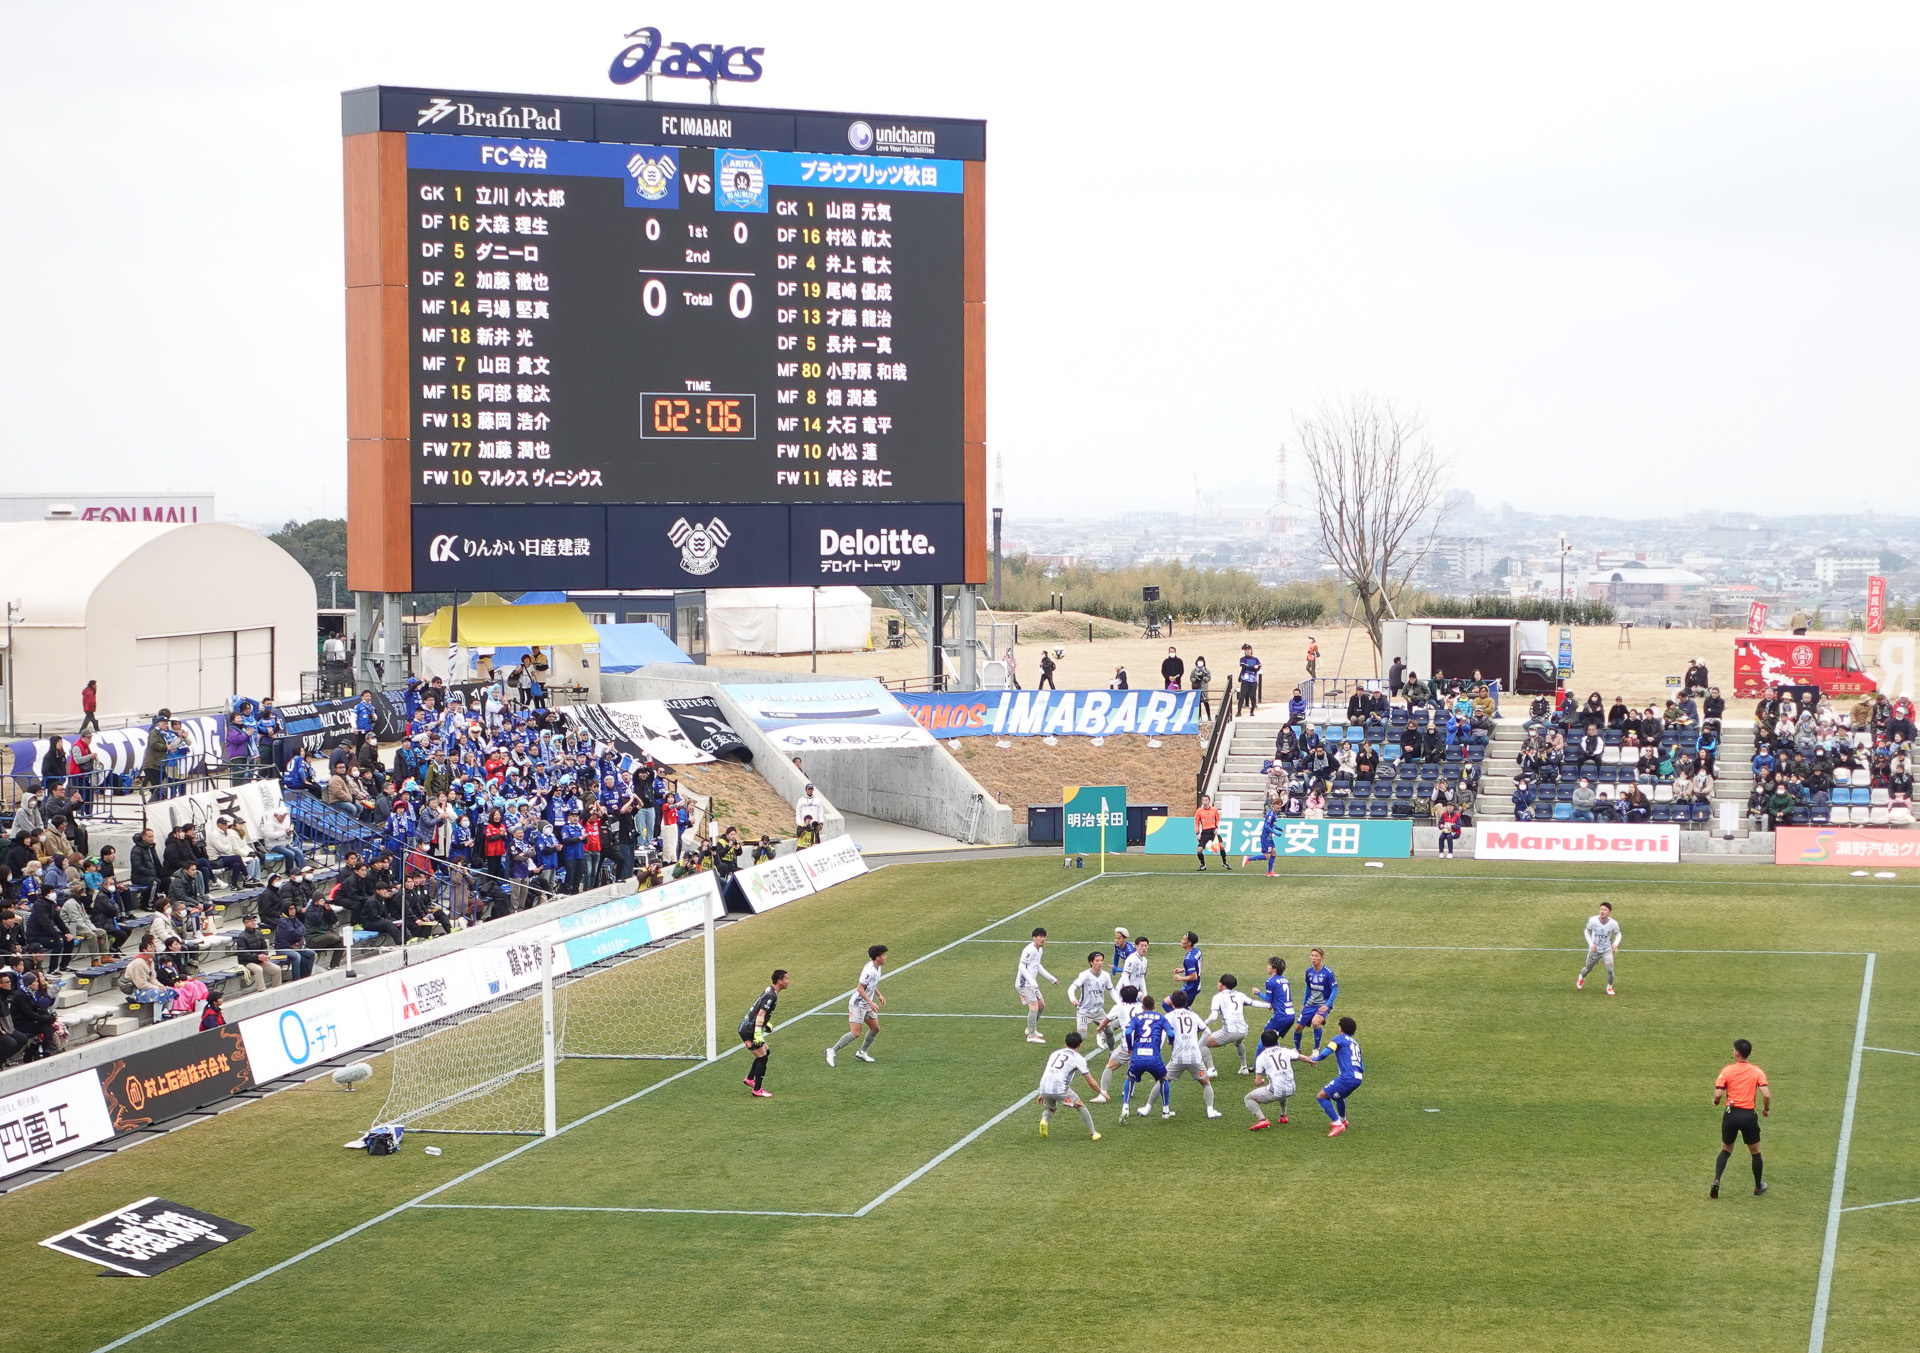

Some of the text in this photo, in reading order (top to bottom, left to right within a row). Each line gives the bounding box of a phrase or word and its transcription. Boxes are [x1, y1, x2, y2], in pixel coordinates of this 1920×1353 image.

[661, 41, 765, 84] asics
[457, 102, 562, 131] BrainPad
[662, 116, 732, 138] FC IMABARI
[876, 126, 935, 145] unicharm
[482, 146, 548, 170] FC今治
[890, 145, 902, 153] Your
[902, 146, 935, 154] Possibilities
[729, 159, 755, 168] AKITA
[801, 161, 937, 187] ブラウブリッツ秋田
[683, 173, 712, 194] VS
[419, 184, 566, 209] GK 1 立川 小太郎
[775, 199, 893, 223] GK 1 山田 元気
[421, 213, 549, 236] DF 16 大森 理生
[646, 218, 748, 244] 0 1st 0
[777, 226, 893, 249] DF 16 村松 航太
[421, 241, 539, 262] DF 5 ダニーロ
[686, 249, 710, 263] 2nd
[777, 254, 892, 275] DF 4 井上 竜太
[422, 270, 550, 292] DF 2 加藤 徹也
[777, 280, 798, 297] DF
[802, 281, 821, 298] 19
[860, 281, 893, 302] 優成
[421, 299, 446, 315] MF
[450, 299, 471, 316] 14
[477, 298, 511, 319] 弓場
[643, 279, 753, 319] 0 Total 0
[777, 307, 893, 329] DF 13 才藤 龍治
[421, 326, 534, 347] MF 18 新井 光
[777, 334, 893, 355] DF 5 長井 一真
[422, 355, 551, 376] MF 7 山田 貴文
[777, 361, 908, 382] MF 80 小野原 和哉
[422, 384, 447, 400] MF
[451, 384, 472, 401] 15
[477, 382, 513, 403] 阿部
[685, 380, 712, 391] TIME
[777, 388, 799, 404] MF
[806, 388, 817, 405] 8
[825, 388, 843, 407] 畑
[422, 410, 551, 432] FW 13 藤岡 浩介
[654, 399, 742, 432] 02:06
[777, 415, 893, 435] MF 14 大石 竜平
[422, 440, 552, 460] FW 77 加藤 潤也
[776, 442, 879, 461] FW 10 小松 蓮
[422, 468, 604, 488] FW 10 マルクス ヴィニシウス
[776, 470, 800, 486] FW
[803, 470, 821, 486] 11
[861, 468, 893, 488] 政仁
[463, 538, 590, 557] りんかい日産建設
[820, 528, 936, 556] Deloitte.
[820, 560, 901, 573] デロイト トーマツ
[766, 693, 788, 702] the
[792, 691, 825, 702] Next
[827, 689, 872, 701] Stage!
[992, 690, 1197, 734] IMABARI
[617, 718, 640, 728] YOUR
[620, 727, 642, 735] OCAL
[809, 731, 918, 746] 新来島どっく
[1067, 811, 1124, 829] 明治安田
[1486, 832, 1669, 852] Marubeni
[414, 977, 447, 999] MITSUBISHI
[1282, 983, 1290, 1001] 7
[418, 993, 447, 1014] ELECTRIC
[1230, 995, 1239, 1011] 5
[1142, 1019, 1153, 1038] 5
[1177, 1016, 1193, 1034] 19
[1051, 1053, 1069, 1070] 13
[1269, 1053, 1288, 1071] 16
[143, 1053, 231, 1098] 村上石油株式会社
[0, 1103, 80, 1164] 四電工
